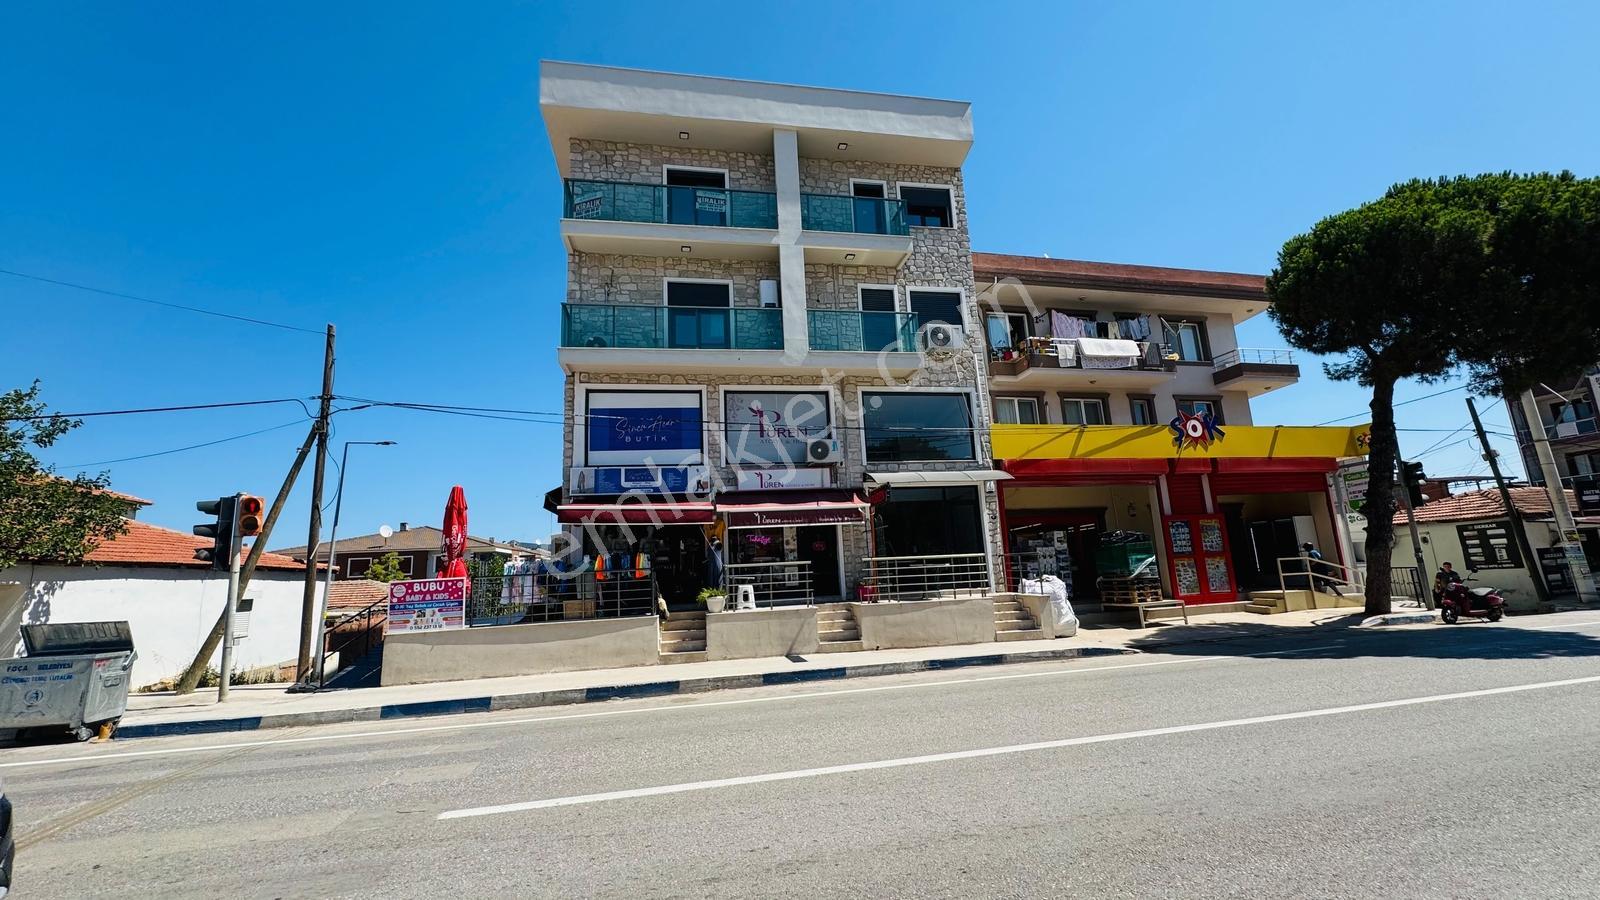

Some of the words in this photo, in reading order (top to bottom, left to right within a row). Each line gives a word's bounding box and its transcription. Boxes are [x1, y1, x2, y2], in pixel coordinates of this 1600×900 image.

[575, 199, 601, 212] KIRALIK
[697, 197, 725, 206] KIRALIK
[413, 582, 445, 592] BUBU
[406, 594, 423, 602] BABY
[7, 665, 28, 673] FOÇA
